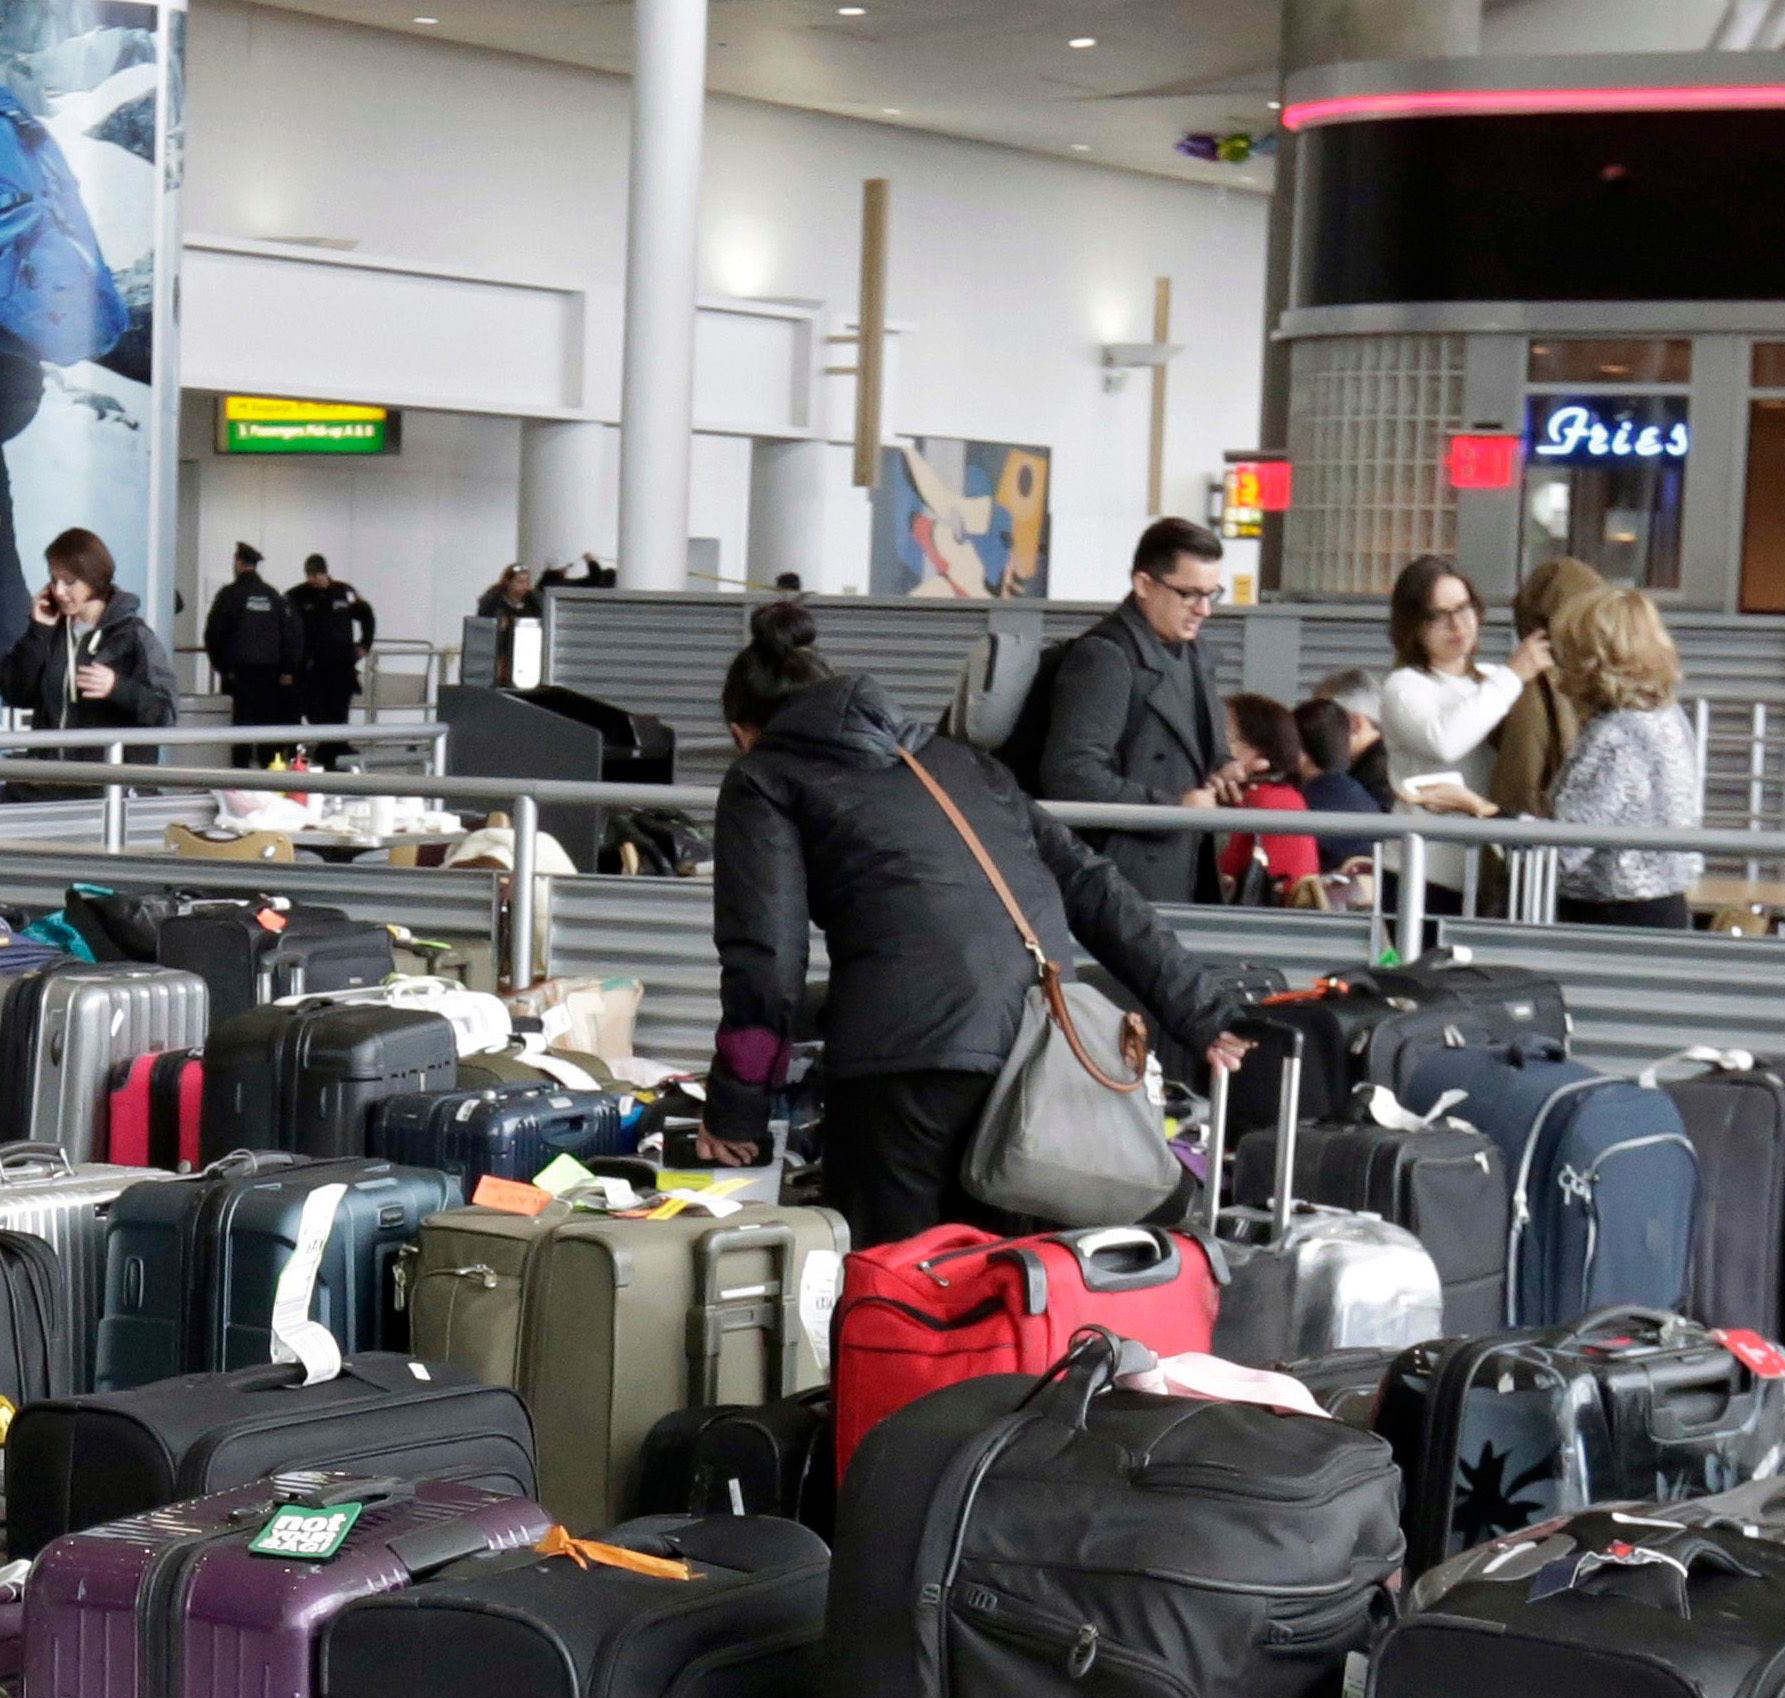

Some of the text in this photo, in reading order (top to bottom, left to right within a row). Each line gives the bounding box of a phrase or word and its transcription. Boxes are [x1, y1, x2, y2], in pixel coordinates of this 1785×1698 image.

[1534, 405, 1690, 457] Fries
[273, 1513, 347, 1532] not
[272, 1529, 337, 1543] YOUR
